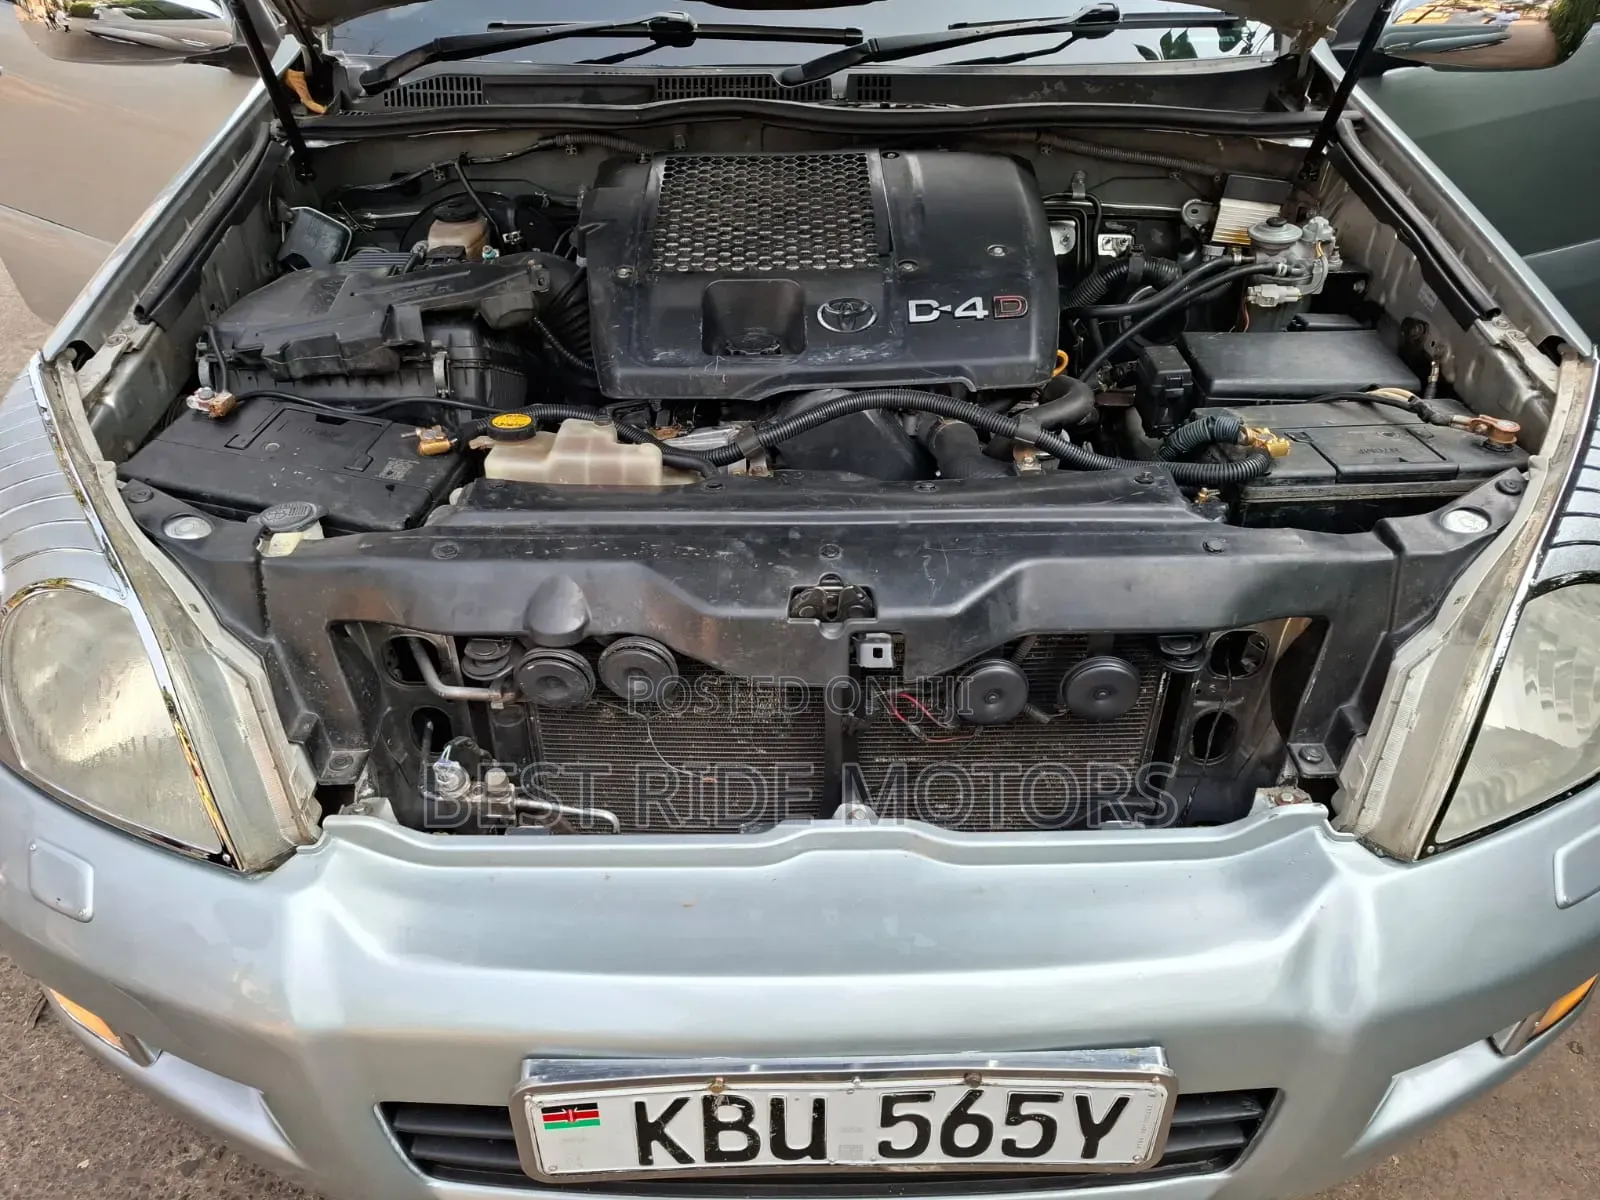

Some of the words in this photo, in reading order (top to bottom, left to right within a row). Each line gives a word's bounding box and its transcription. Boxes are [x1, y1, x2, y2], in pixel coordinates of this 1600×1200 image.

[908, 295, 1028, 322] D-4D
[634, 1094, 829, 1166] KBU
[876, 1089, 1132, 1160] 565Y
